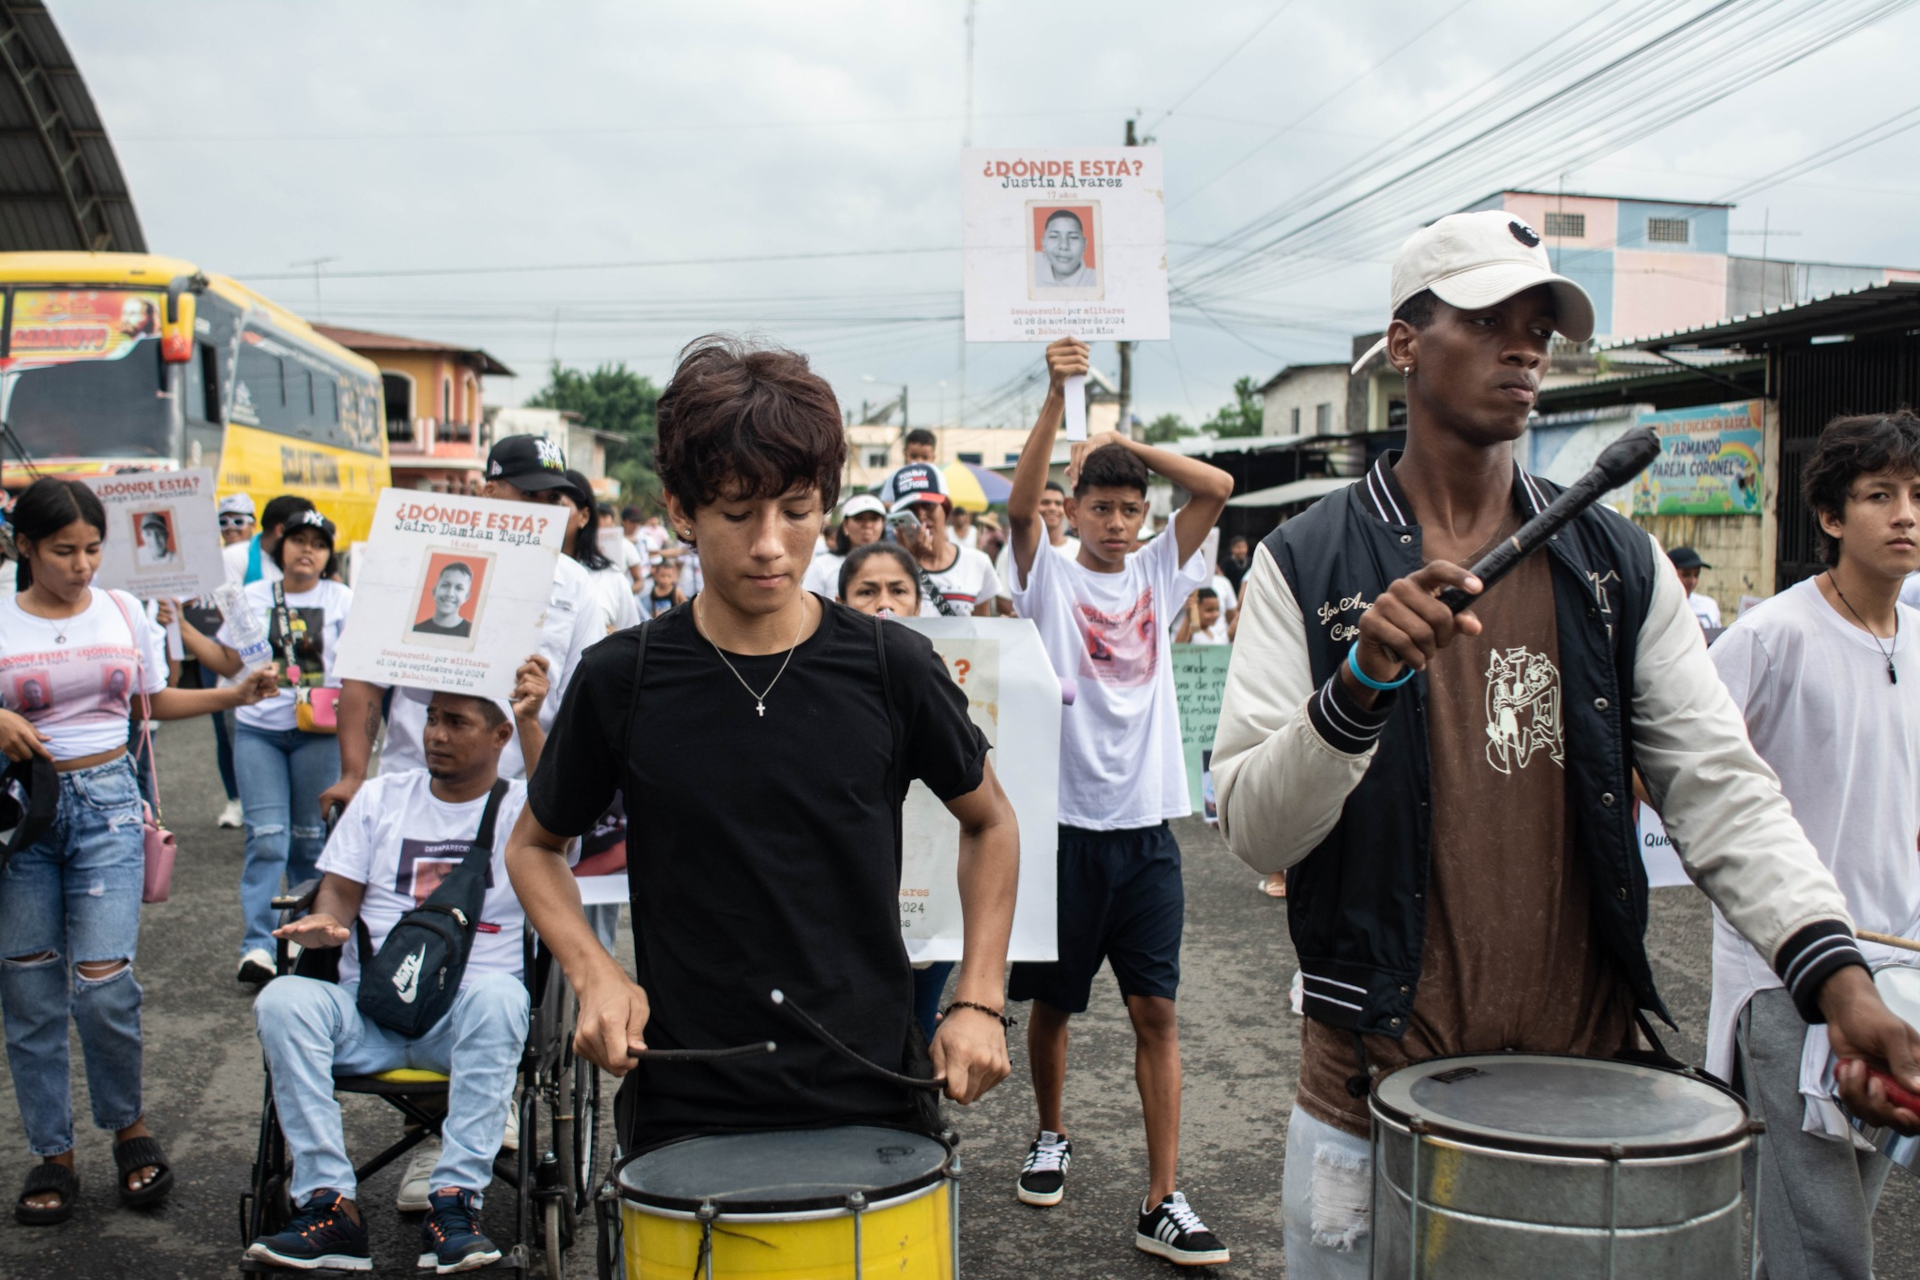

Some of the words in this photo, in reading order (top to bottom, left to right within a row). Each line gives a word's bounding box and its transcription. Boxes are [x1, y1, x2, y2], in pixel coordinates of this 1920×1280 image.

[983, 158, 1074, 177] ¿DÓNDE
[1080, 158, 1143, 177] ESTÁ?
[1060, 175, 1122, 188] Alvarez
[1047, 191, 1056, 199] 17
[1010, 307, 1066, 317] desaparecido
[1067, 308, 1081, 317] por
[1083, 307, 1125, 315] militares
[1013, 317, 1022, 325] el
[1037, 317, 1047, 325] de
[1049, 317, 1092, 325] noviembre
[1093, 317, 1103, 325] de
[1105, 317, 1125, 325] 2024
[1080, 327, 1094, 335] los
[898, 469, 927, 481] TOMMY
[1652, 460, 1686, 477] PAREJA
[97, 481, 155, 497] ¿DÓNDE
[158, 475, 200, 491] ESTÁ?
[899, 480, 929, 493] HILFIGER
[396, 503, 482, 527] ¿DÓNDE
[486, 513, 549, 535] ESTÁ?
[395, 518, 437, 534] Jairo
[499, 530, 541, 547] Tapia
[1317, 601, 1340, 625] Los
[1330, 623, 1361, 641] Califo
[381, 648, 434, 661] desaparecido
[449, 657, 491, 669] militares
[376, 658, 385, 666] el
[398, 660, 408, 669] de
[409, 662, 453, 675] septiembre
[454, 668, 465, 676] de
[465, 670, 486, 679] 2024
[441, 676, 455, 685] los
[1195, 675, 1208, 690] de
[1645, 833, 1671, 848] Que
[424, 844, 471, 853] DESAPARECID
[899, 888, 930, 897] ares
